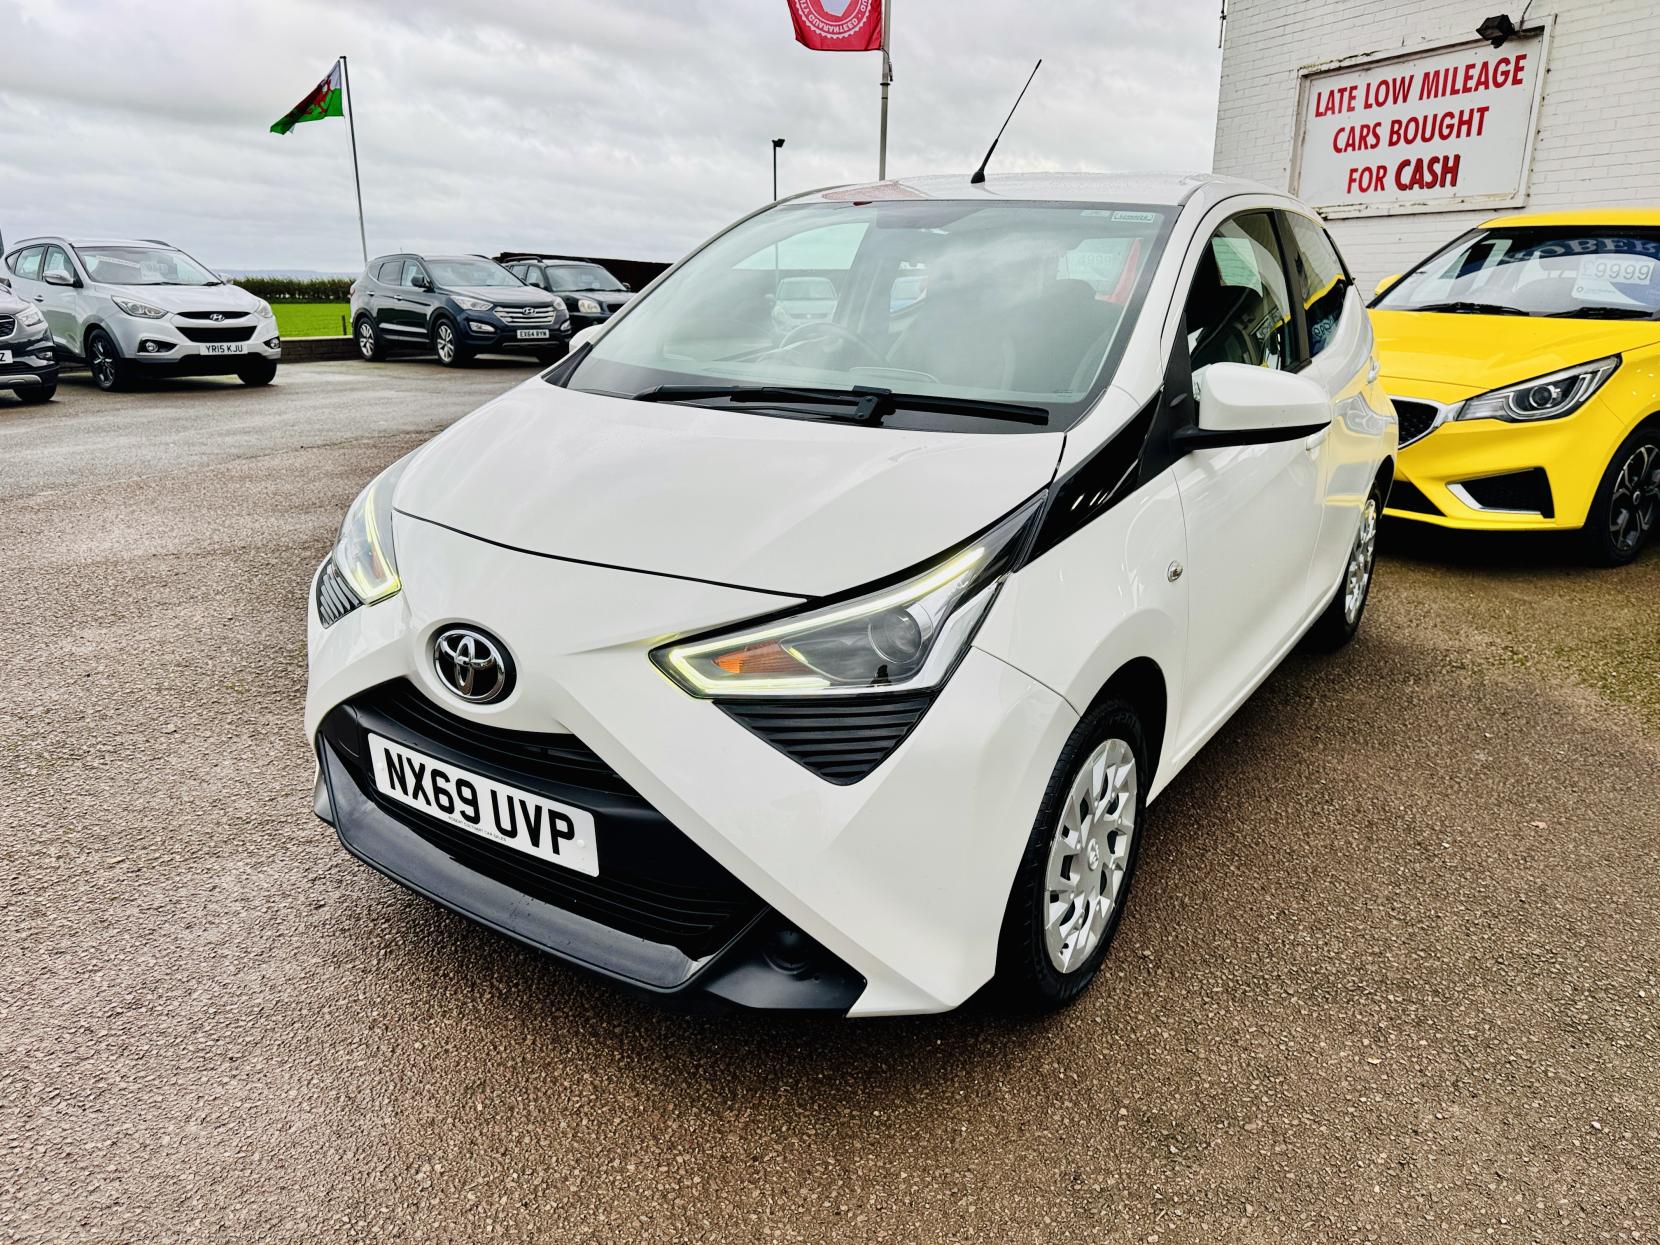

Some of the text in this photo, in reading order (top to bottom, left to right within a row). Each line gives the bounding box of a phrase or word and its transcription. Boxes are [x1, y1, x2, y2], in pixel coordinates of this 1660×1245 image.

[1315, 54, 1527, 117] LATE LOW MILEAGE
[1332, 106, 1490, 154] CARS BOUGHT
[1346, 154, 1461, 194] FOR CASH
[205, 343, 243, 353] YR15 KJU
[384, 747, 576, 856] NX69 UVP
